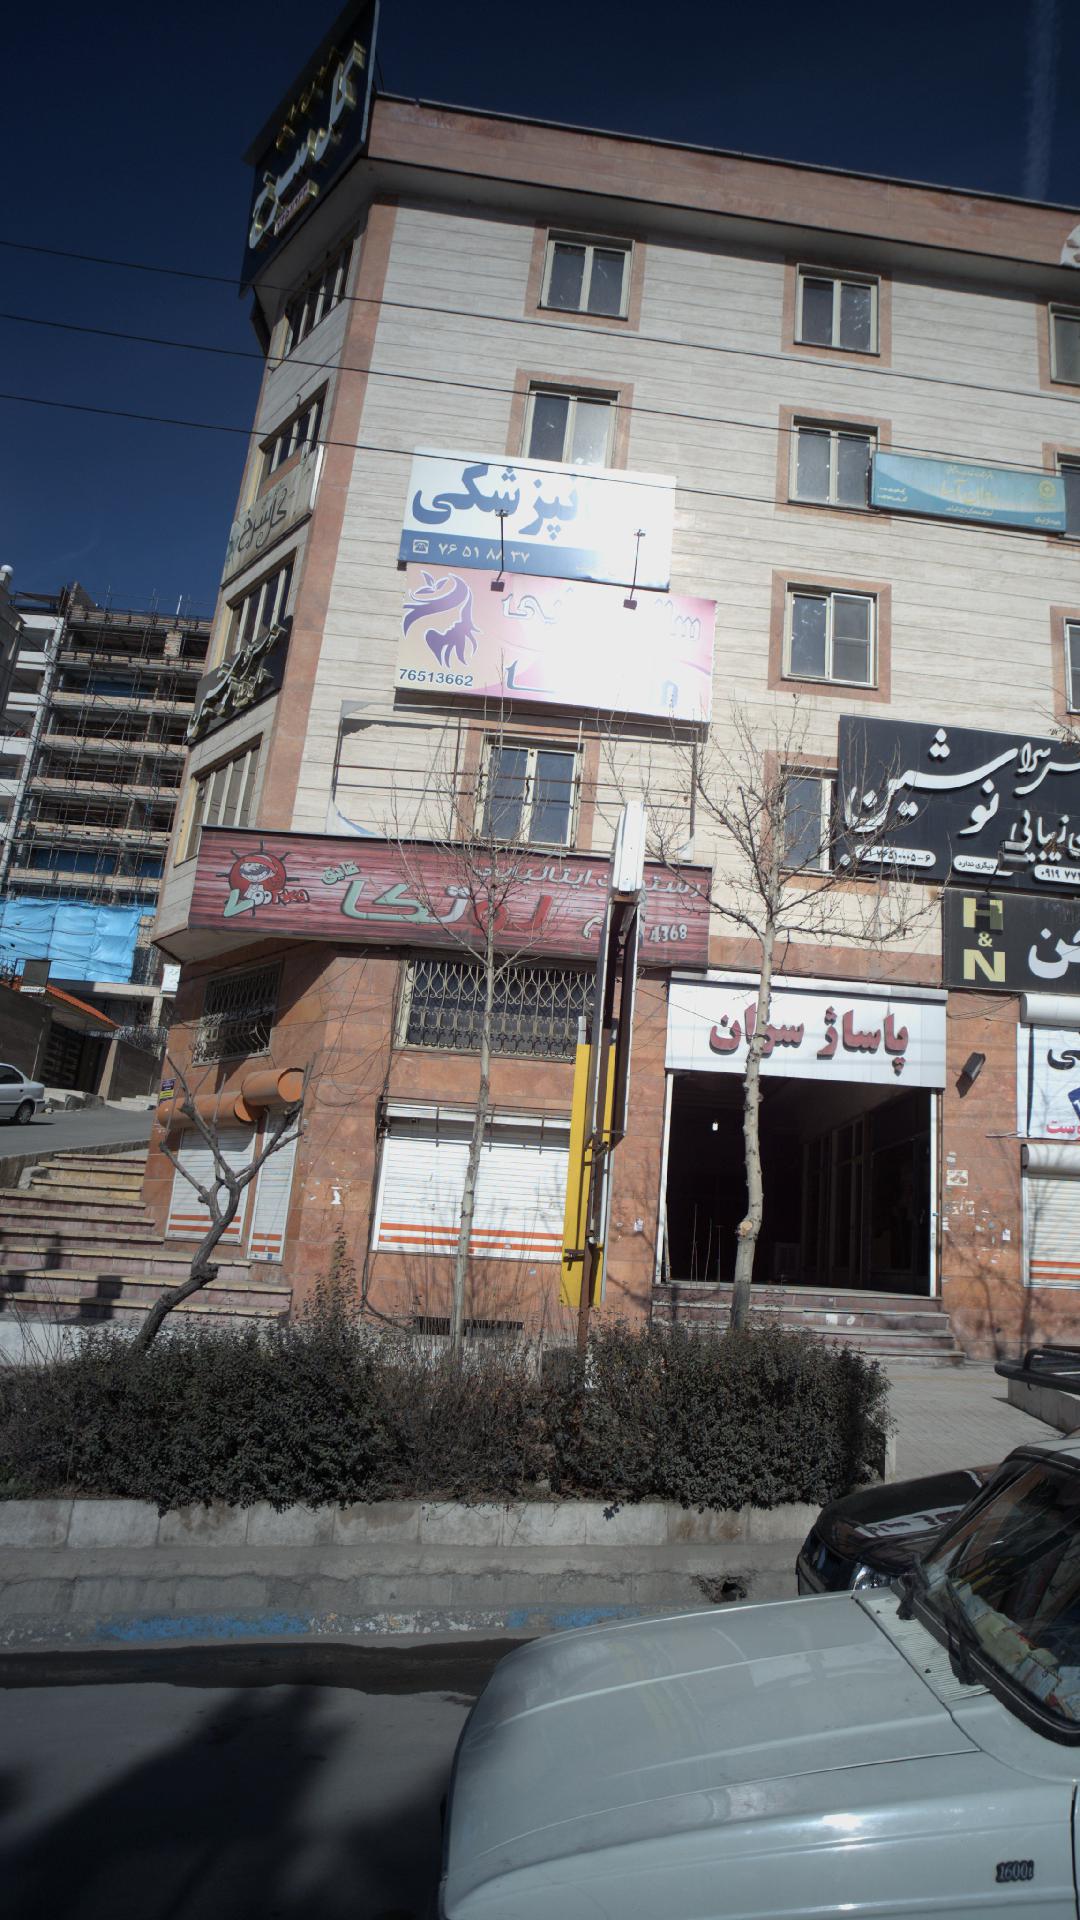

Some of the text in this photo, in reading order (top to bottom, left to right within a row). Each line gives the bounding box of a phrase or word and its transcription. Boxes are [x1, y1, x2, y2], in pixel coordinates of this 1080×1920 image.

[412, 464, 580, 540] نپزشکی
[399, 668, 473, 688] 76513662
[977, 931, 993, 948] &
[963, 948, 1006, 983] N
[817, 1005, 909, 1077] پاساژ
